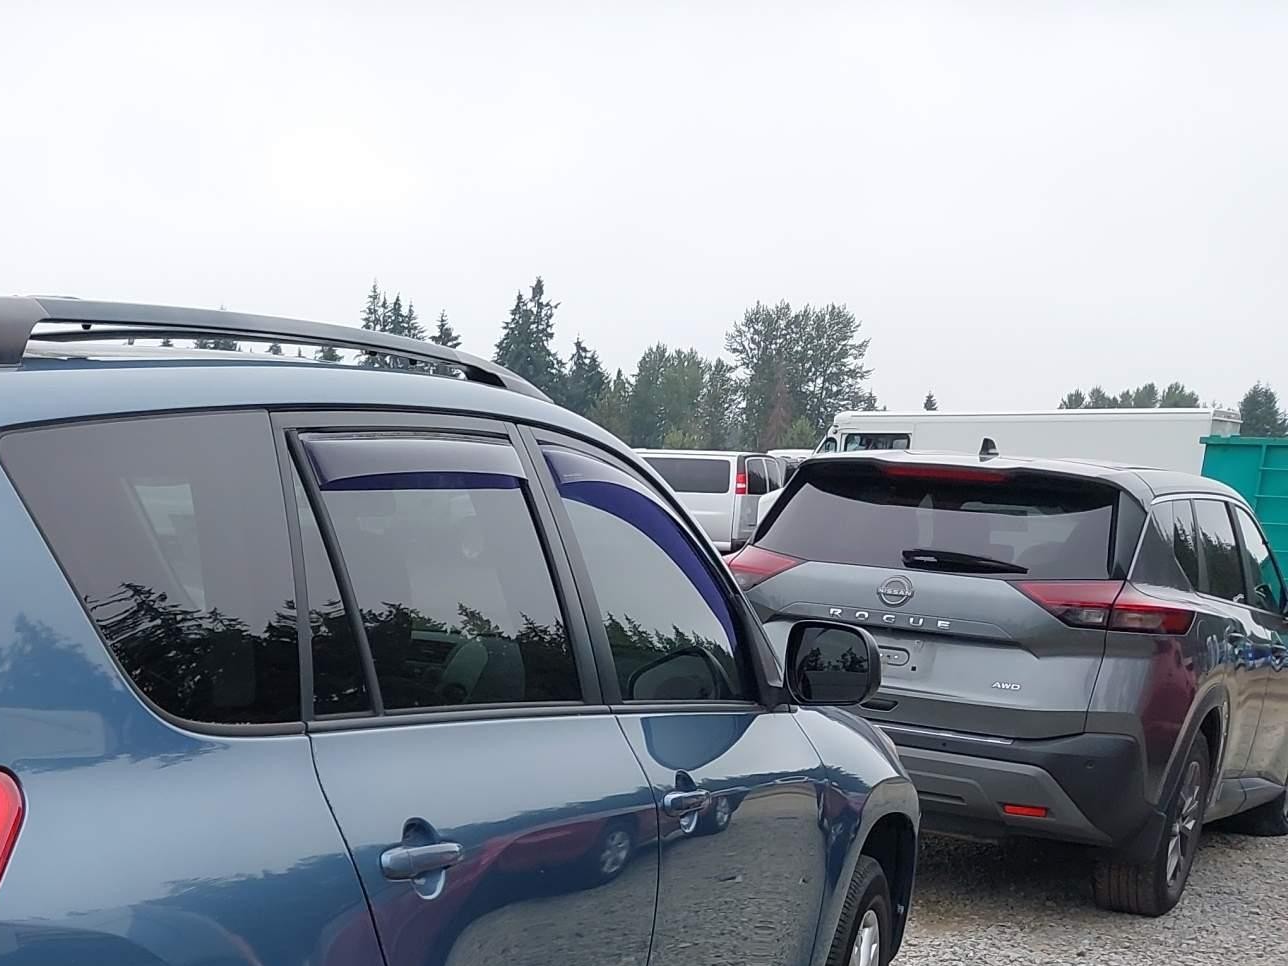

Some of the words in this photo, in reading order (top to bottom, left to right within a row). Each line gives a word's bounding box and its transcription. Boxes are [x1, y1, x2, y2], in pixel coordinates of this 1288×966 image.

[878, 587, 912, 597] NISSAN
[829, 607, 951, 630] ROGUE
[991, 681, 1021, 690] AWD
